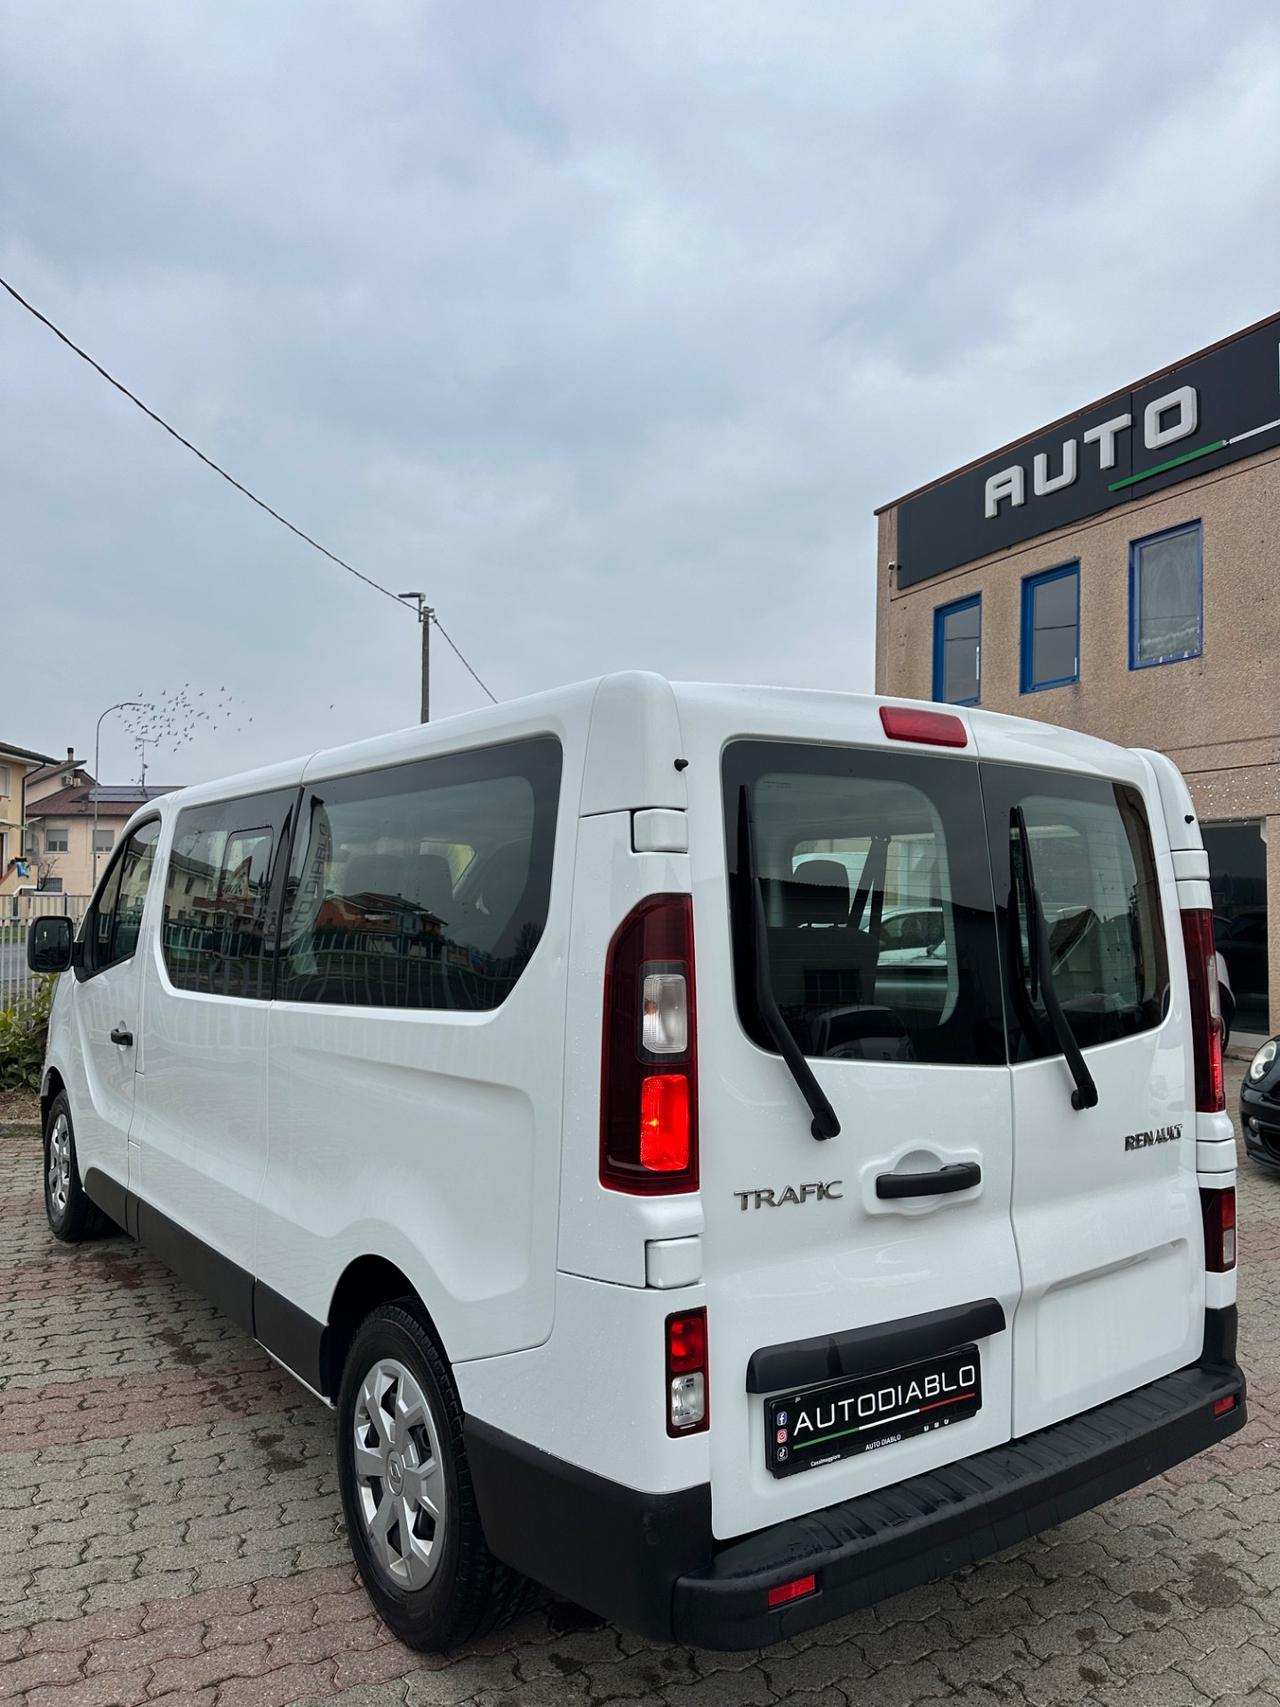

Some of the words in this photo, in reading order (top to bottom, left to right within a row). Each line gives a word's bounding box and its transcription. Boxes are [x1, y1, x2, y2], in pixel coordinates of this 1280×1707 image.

[984, 385, 1198, 519] AUTO
[1125, 1123, 1183, 1152] RENAULT
[733, 1180, 844, 1211] TRAFIC
[793, 1365, 976, 1437] AUTODIABLO
[865, 1439, 881, 1451] AUTO
[881, 1434, 902, 1448] DIABLO
